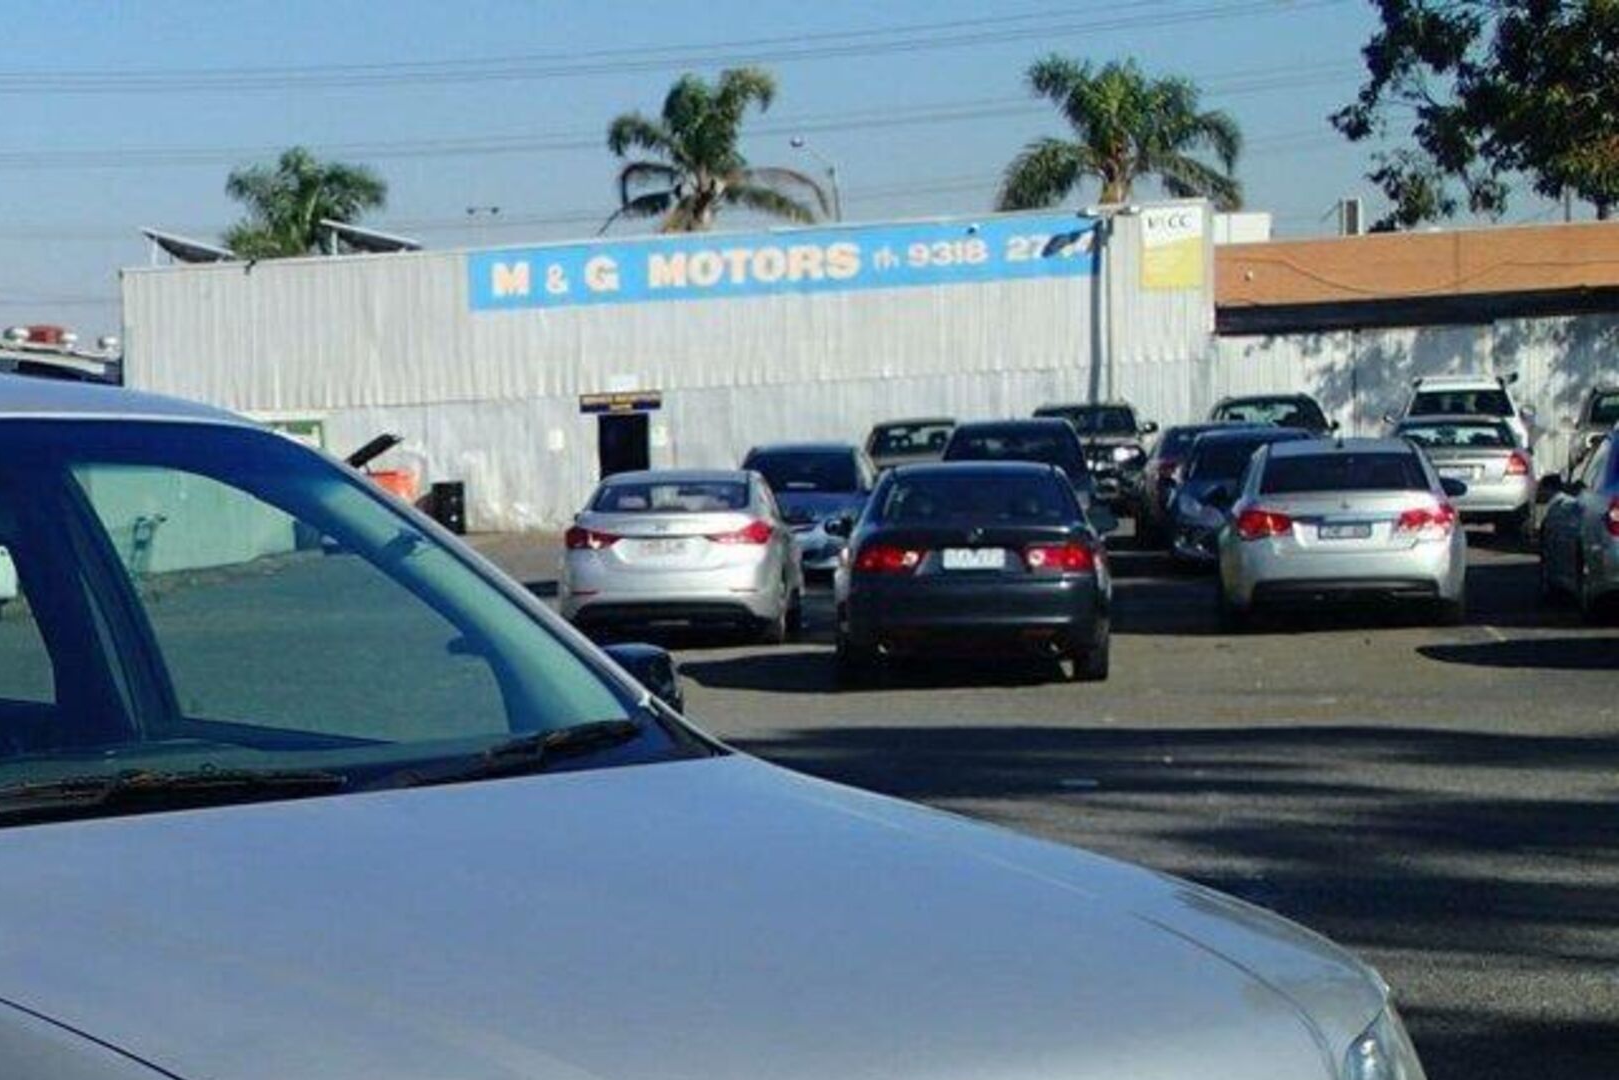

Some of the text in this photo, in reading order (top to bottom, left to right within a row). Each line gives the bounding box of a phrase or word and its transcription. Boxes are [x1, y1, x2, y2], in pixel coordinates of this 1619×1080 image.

[491, 261, 529, 297] M
[546, 264, 568, 295] &
[584, 255, 619, 291] G
[647, 242, 861, 288] MOTORS
[908, 238, 988, 268] 9318
